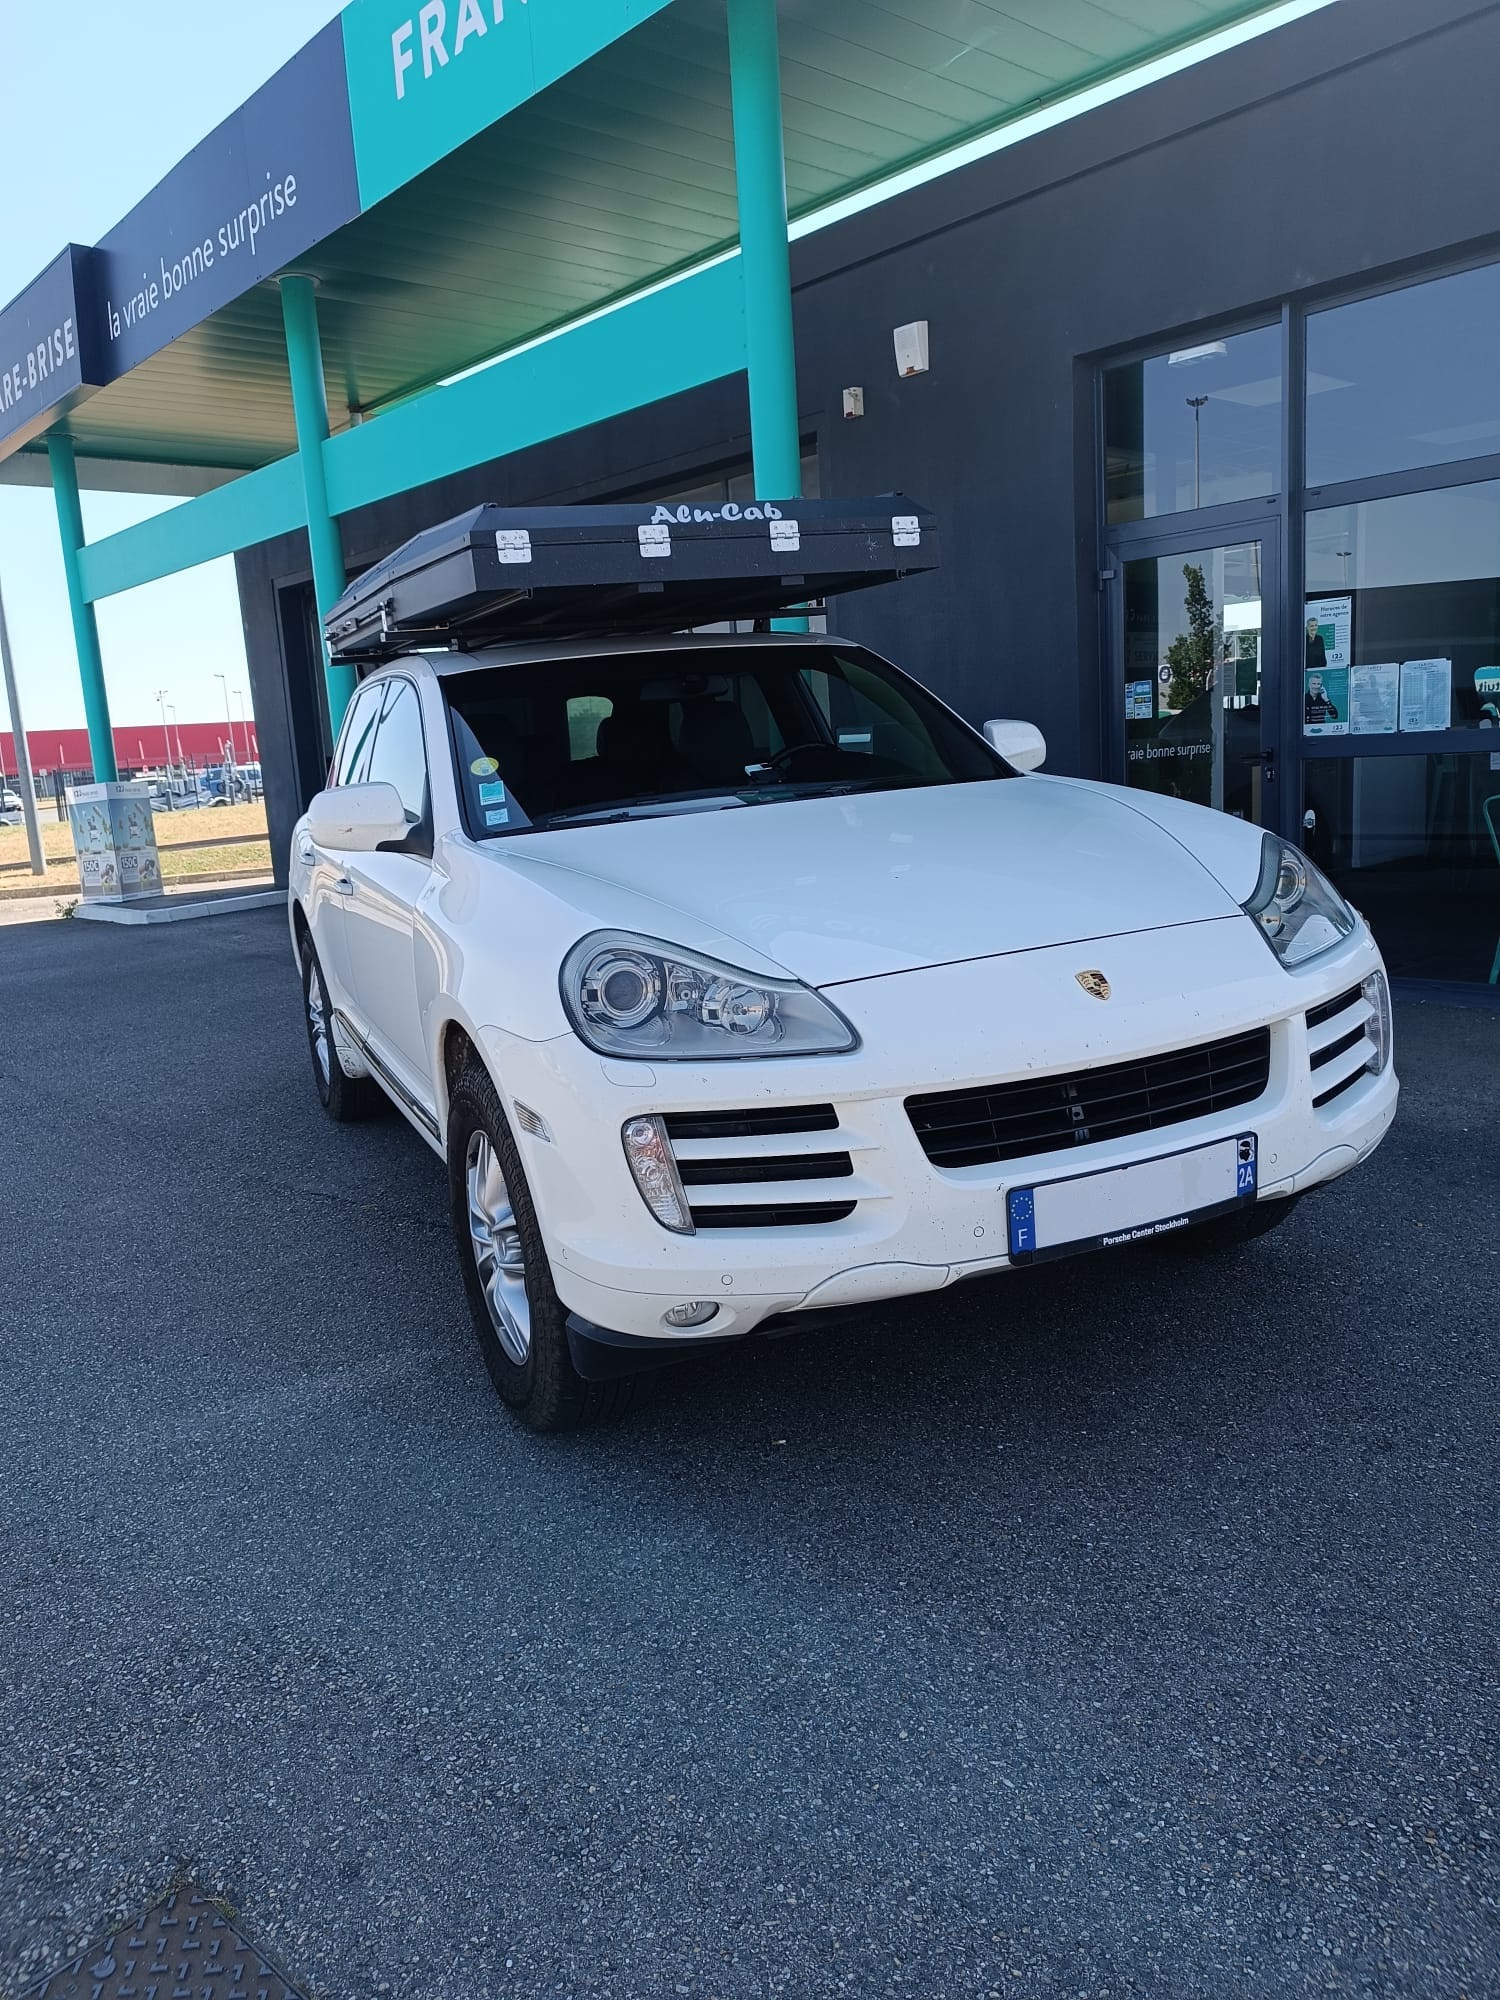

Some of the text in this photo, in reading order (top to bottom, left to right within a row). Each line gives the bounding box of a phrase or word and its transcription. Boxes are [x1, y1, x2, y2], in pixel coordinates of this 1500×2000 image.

[107, 171, 297, 341] la vraie bonne surprise
[650, 502, 783, 525] Alu-Cab
[1146, 743, 1175, 759] bonne
[1177, 738, 1211, 760] surprise
[1239, 1165, 1254, 1188] 2A
[1018, 1228, 1028, 1248] F
[1103, 1217, 1189, 1246] Porsche Center Stockholm
